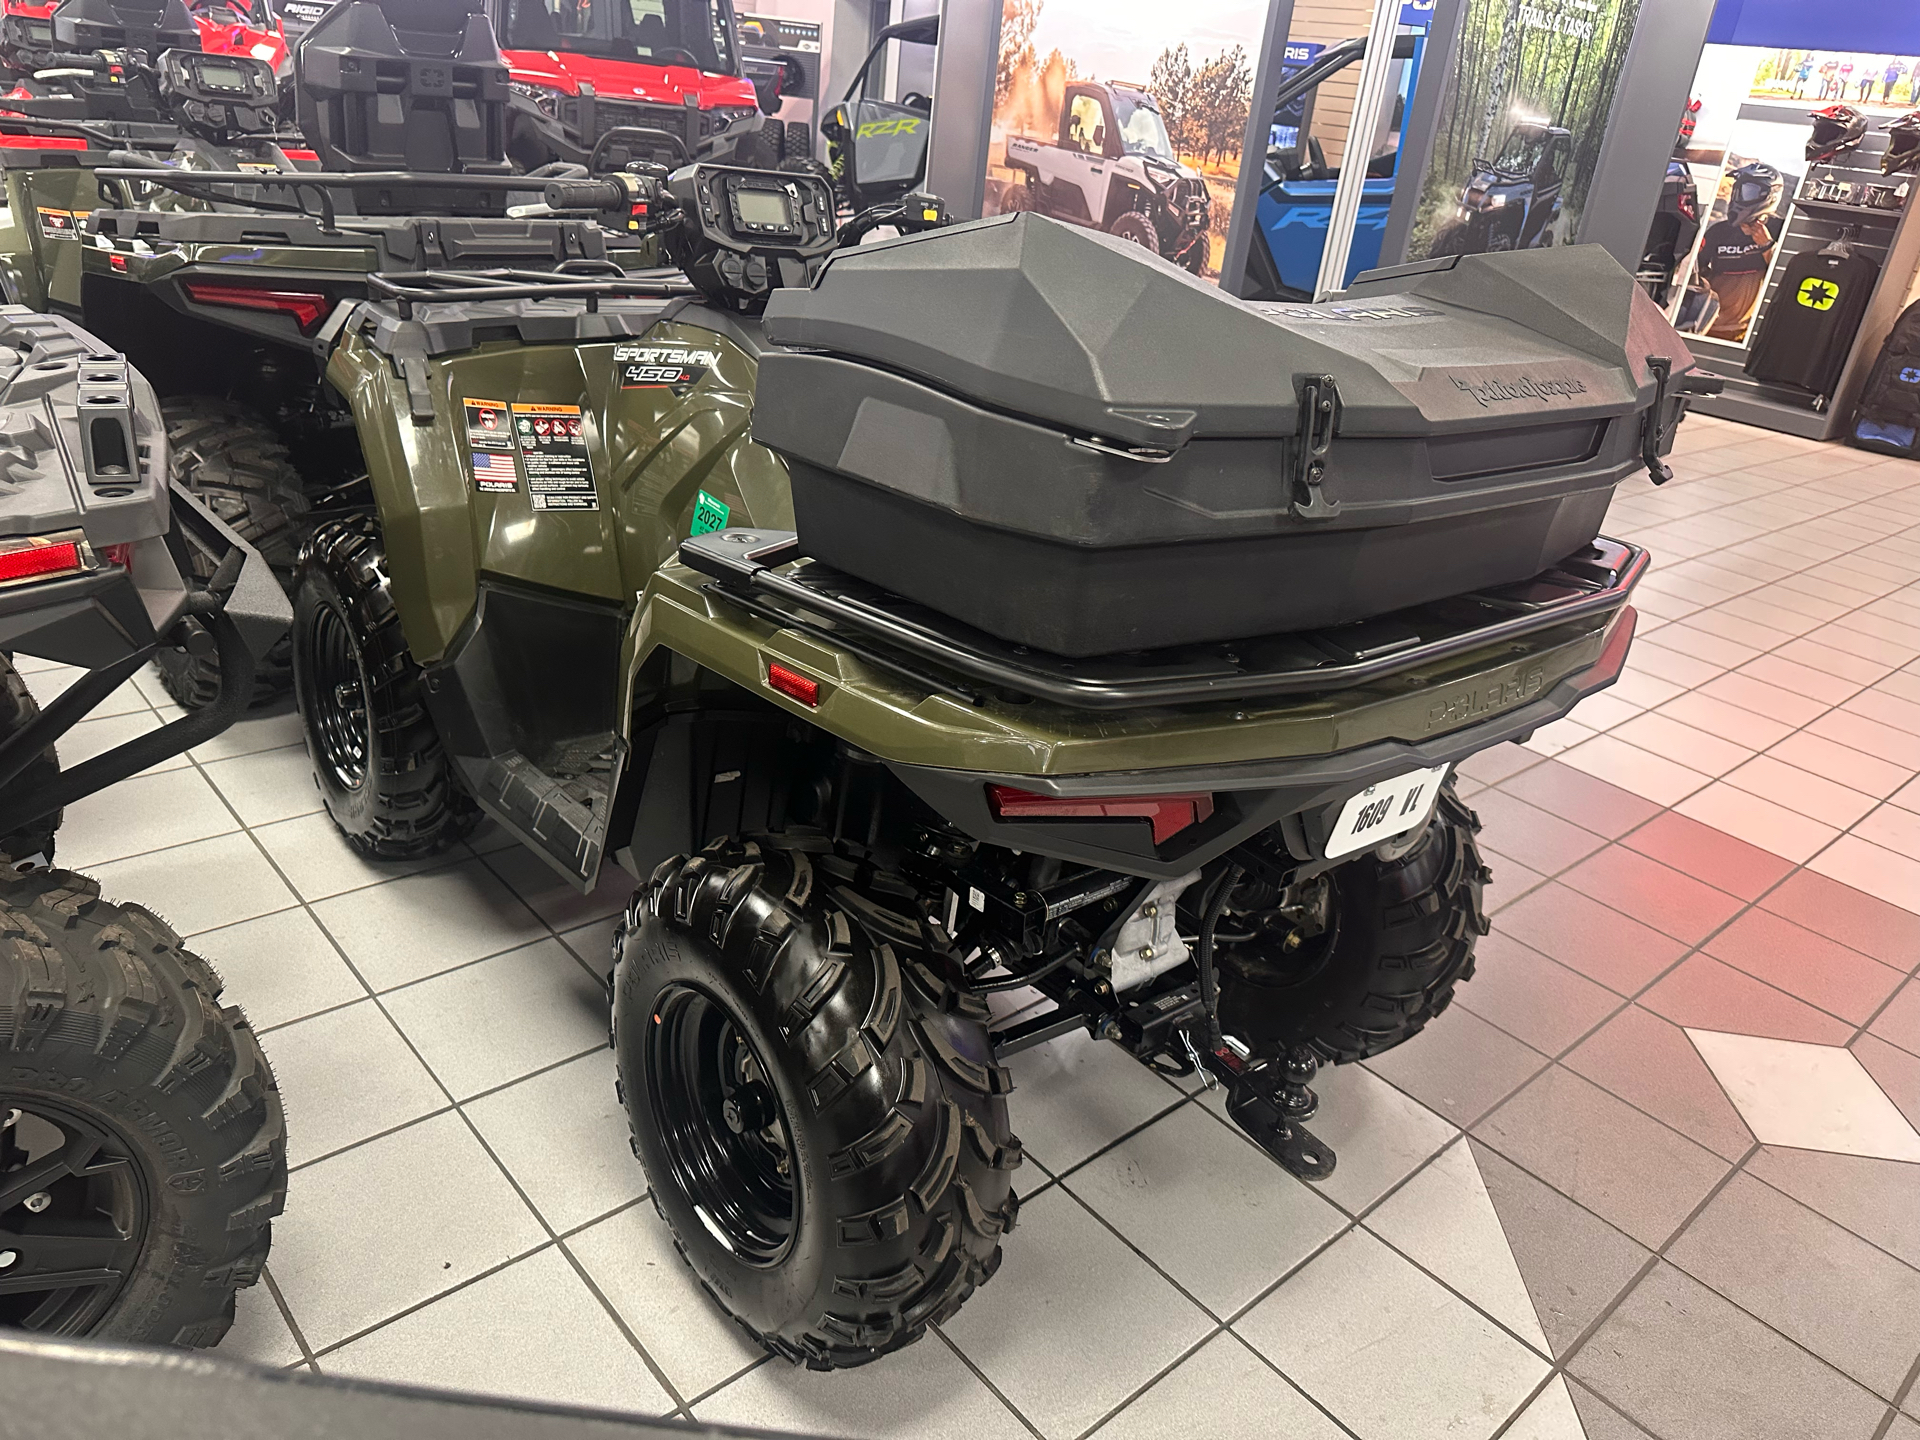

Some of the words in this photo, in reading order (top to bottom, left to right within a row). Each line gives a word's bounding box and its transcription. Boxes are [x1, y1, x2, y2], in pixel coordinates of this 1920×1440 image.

[284, 3, 324, 15] RIGID
[1518, 4, 1553, 30] TRAILS
[1552, 13, 1562, 32] &
[1562, 16, 1593, 40] TASKS
[856, 119, 920, 140] RZR
[613, 345, 728, 373] SPORTSMAN
[626, 366, 683, 383] 450
[697, 506, 723, 531] 2027
[1424, 665, 1544, 732] POLARIS
[1350, 794, 1394, 835] 1609
